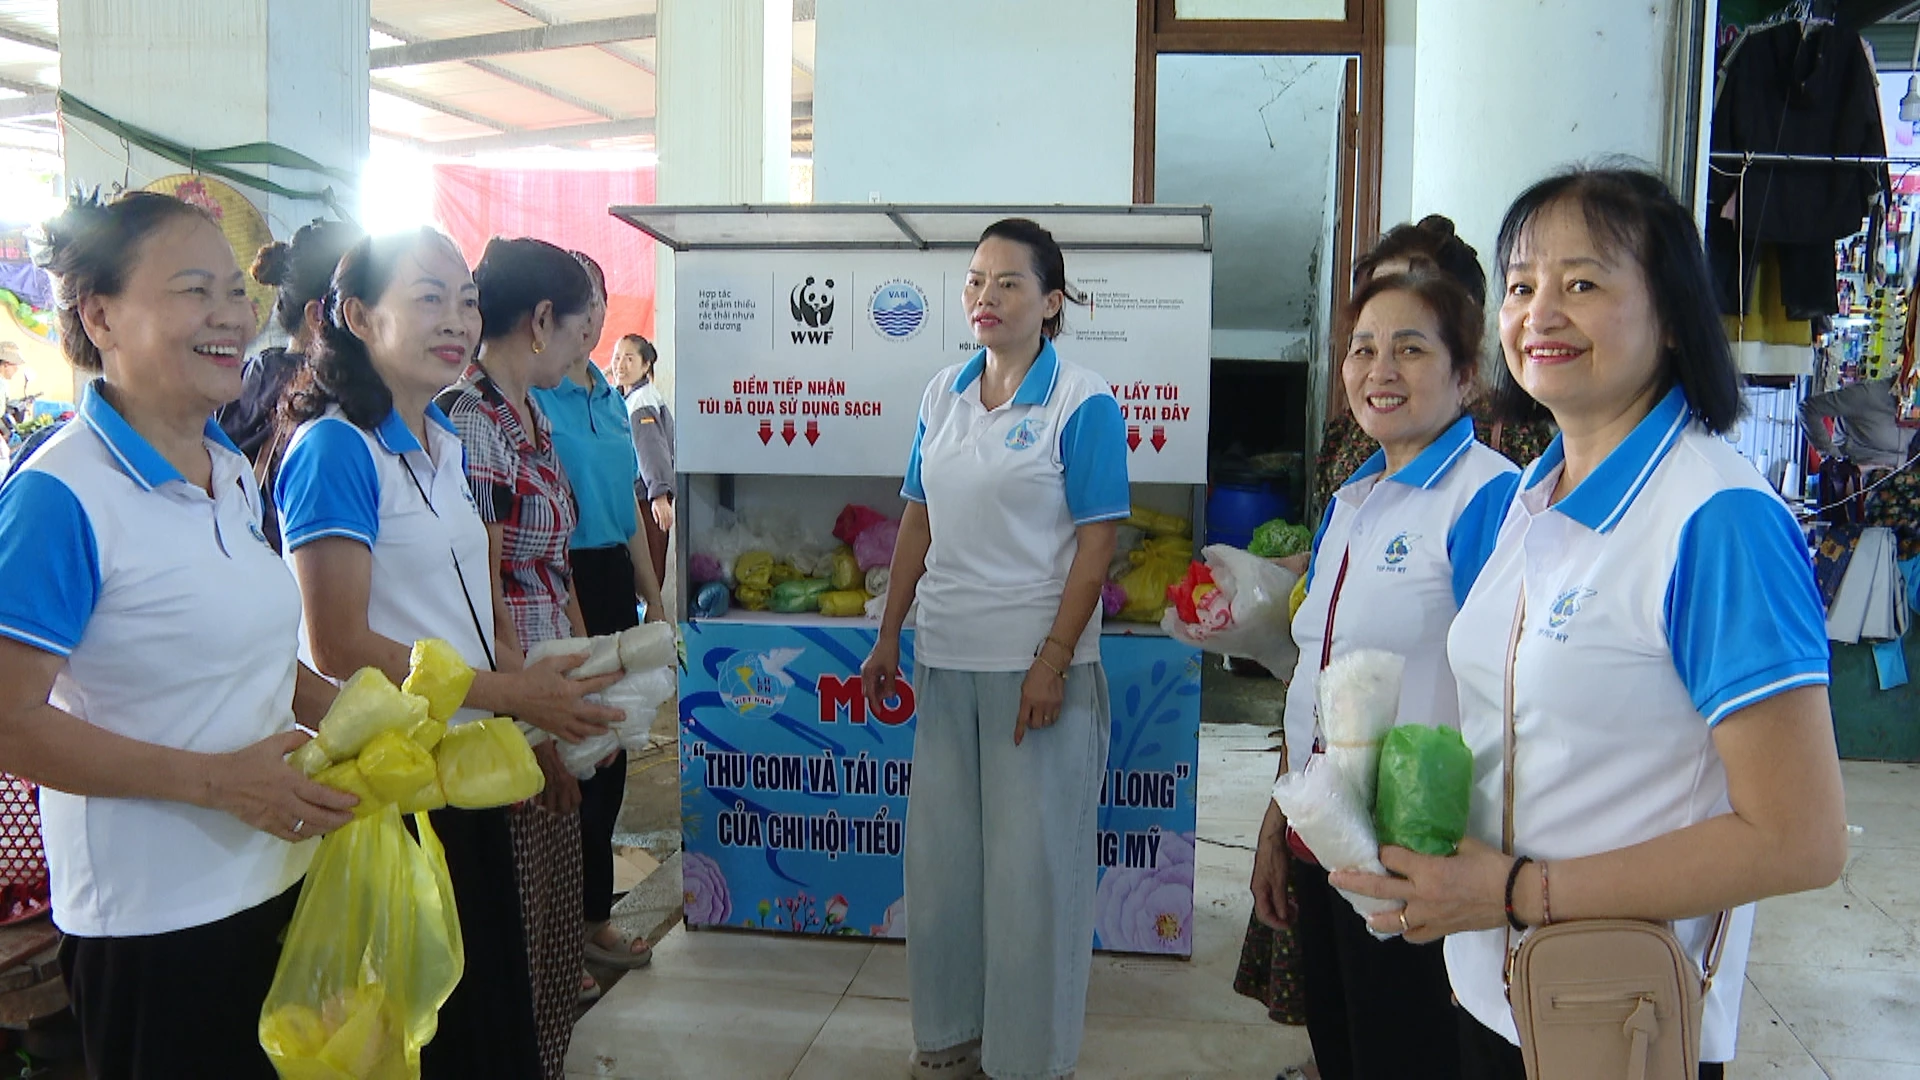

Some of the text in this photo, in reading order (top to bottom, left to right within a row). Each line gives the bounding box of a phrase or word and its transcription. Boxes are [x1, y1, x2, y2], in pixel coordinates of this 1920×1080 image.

[718, 289, 731, 298] tác
[713, 321, 742, 332] dương
[791, 331, 834, 344] WWF
[960, 342, 971, 352] HỘI
[733, 374, 845, 398] ĐIỂM TIẾP NHẬN
[1124, 380, 1150, 400] LẤY
[1155, 382, 1178, 400] TÚI
[698, 397, 881, 418] TÚI ĐÃ QUA SỬ DỤNG SẠCH
[1134, 405, 1156, 424] TẠI
[1161, 403, 1190, 421] ĐÂY
[752, 754, 802, 791] GOM
[807, 749, 838, 794] VÀ
[842, 750, 878, 796] TÁI
[883, 760, 913, 797] CH
[718, 800, 902, 861] CỦA CHI HỘI TIỂU
[1124, 825, 1161, 869] MỸ
